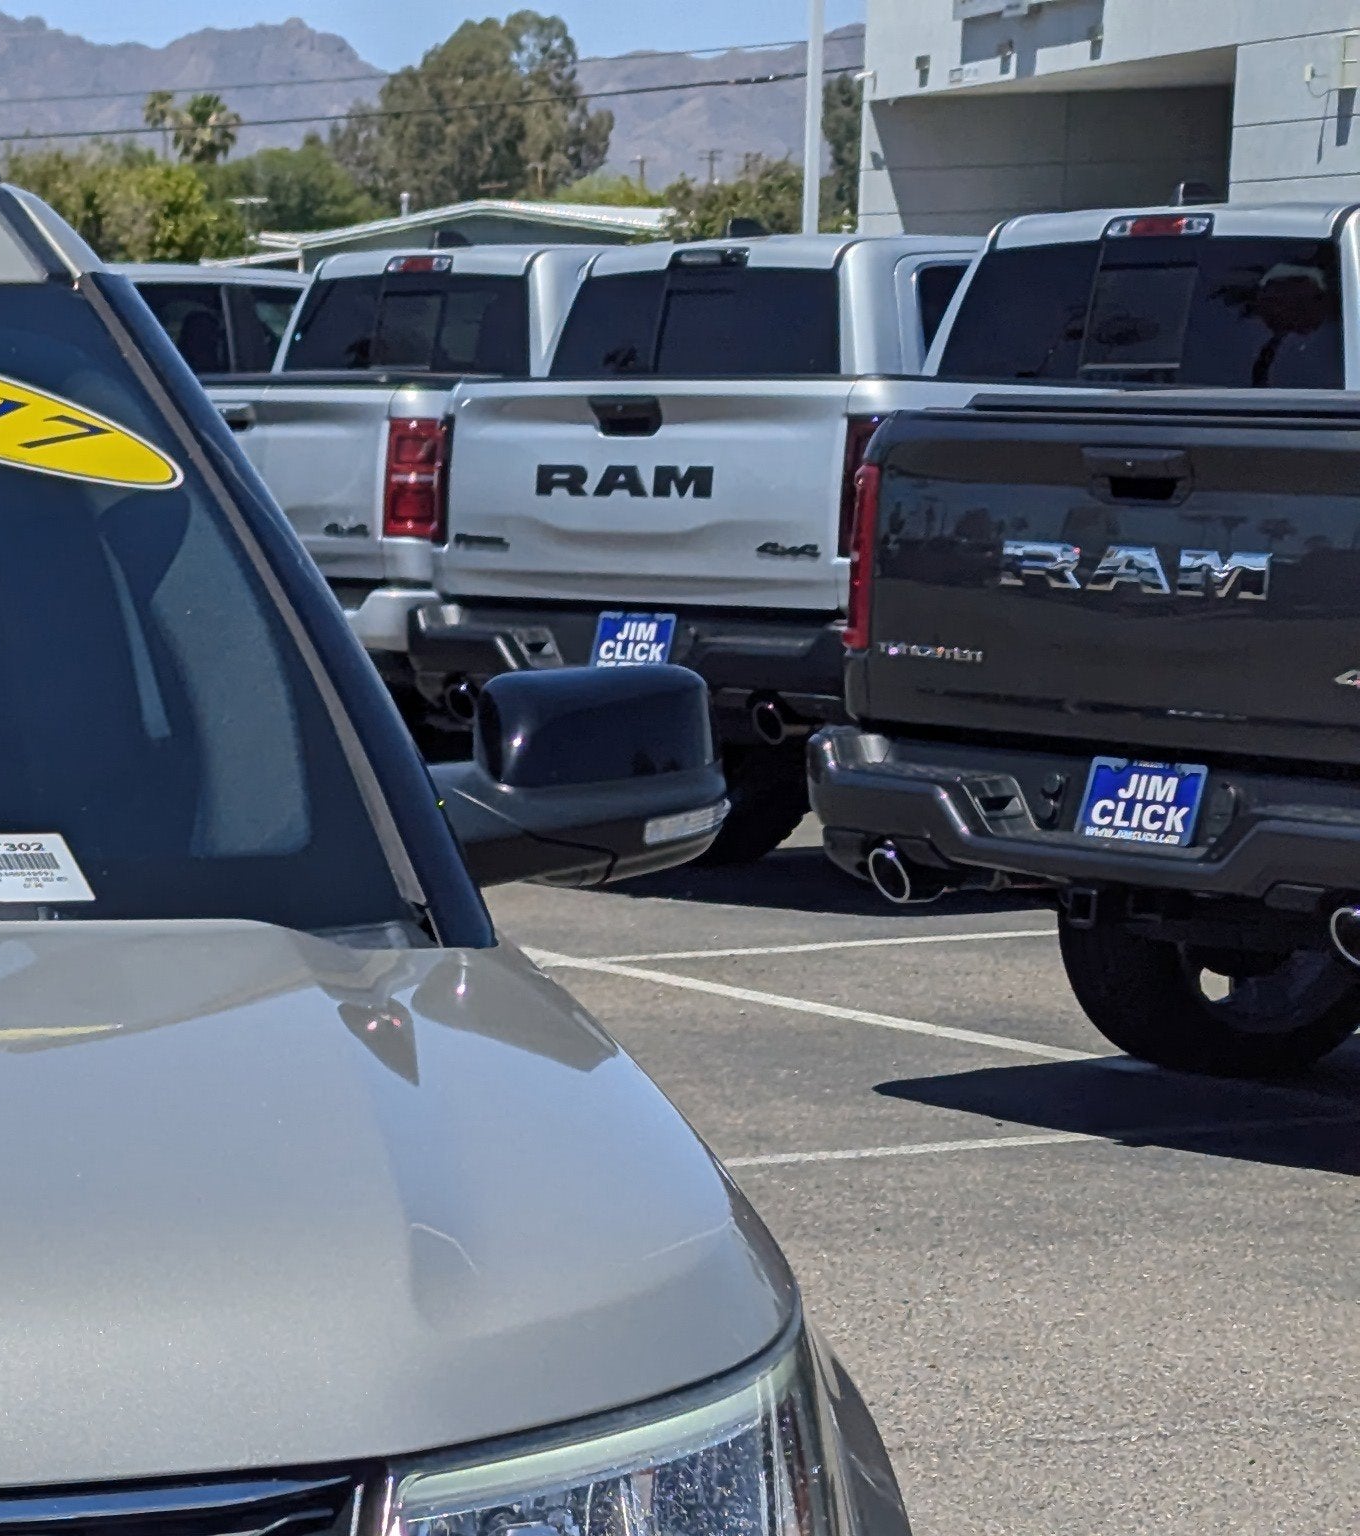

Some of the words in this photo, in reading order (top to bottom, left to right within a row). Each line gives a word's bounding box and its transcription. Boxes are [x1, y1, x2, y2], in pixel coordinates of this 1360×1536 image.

[535, 463, 714, 499] RAM
[998, 540, 1274, 601] RAM
[616, 621, 658, 642] JIM
[599, 640, 665, 662] CLICK
[1118, 773, 1179, 803] JIM
[1091, 799, 1190, 833] CLICK
